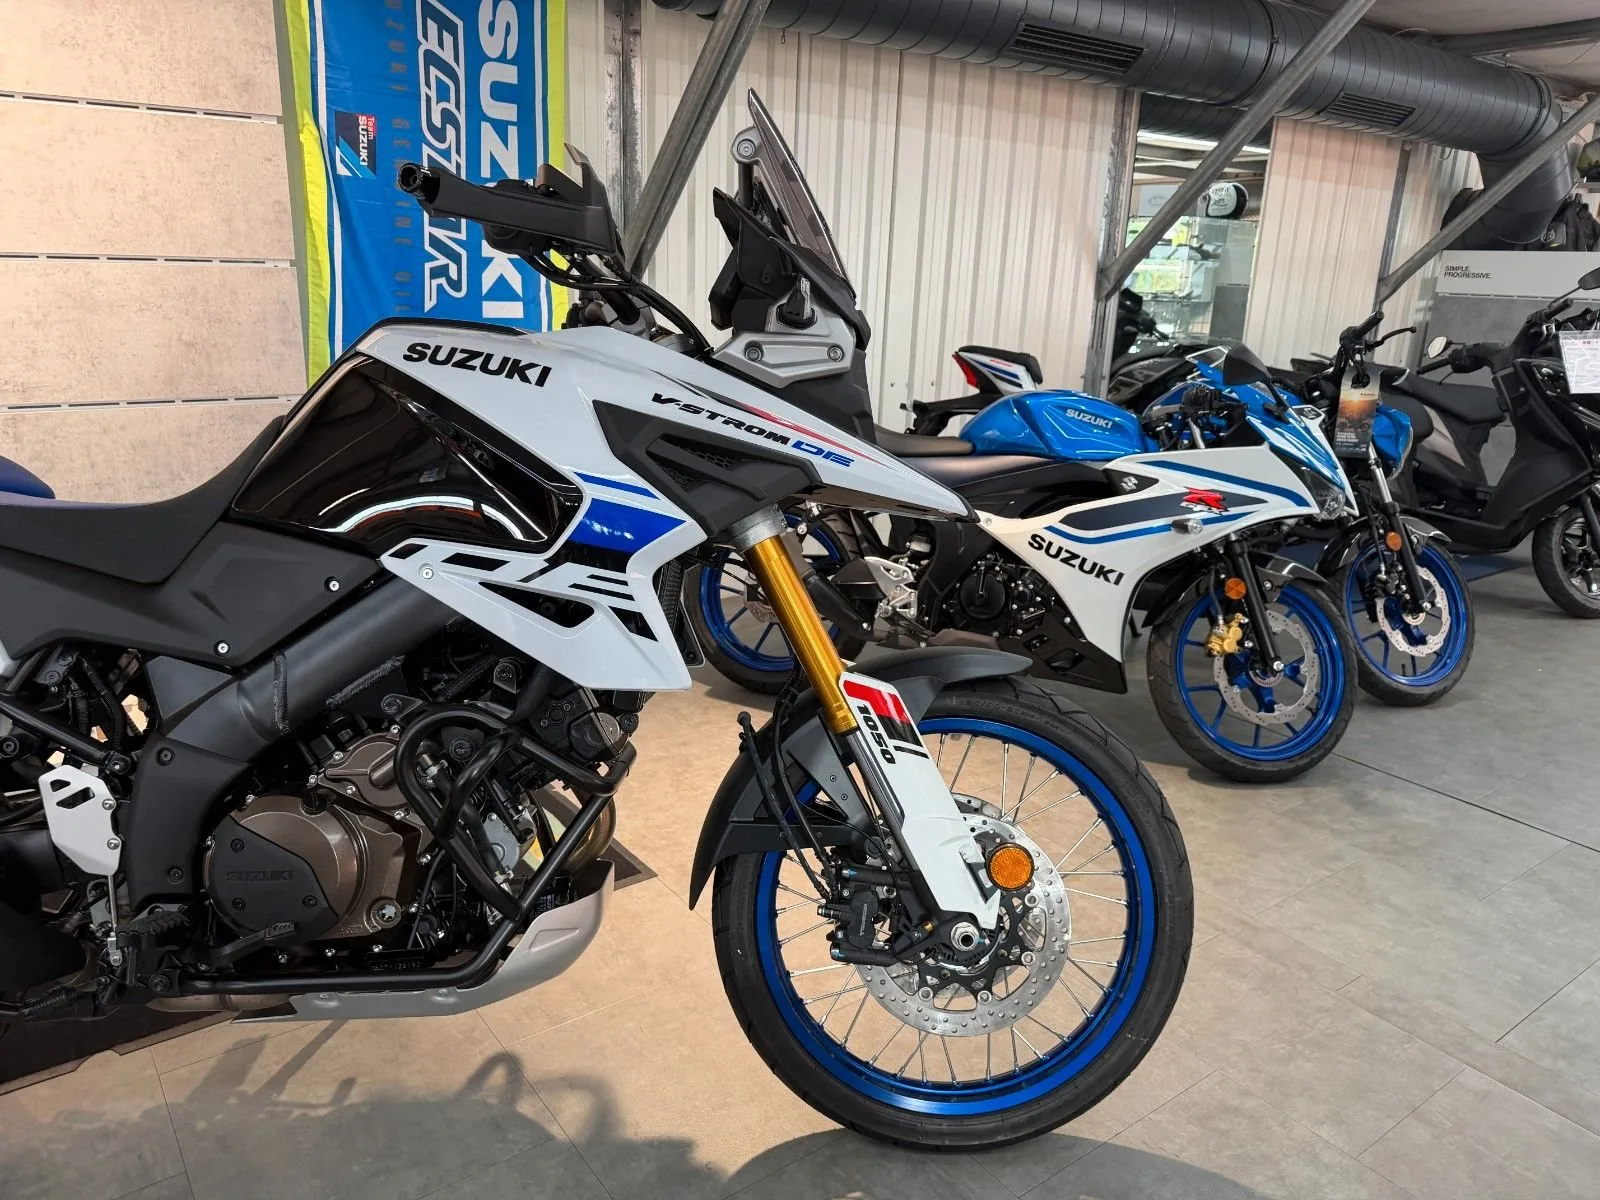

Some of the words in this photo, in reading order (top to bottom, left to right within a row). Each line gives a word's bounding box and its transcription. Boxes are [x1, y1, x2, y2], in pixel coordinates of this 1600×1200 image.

[358, 115, 368, 166] SUZUKI
[367, 117, 375, 140] Team
[392, 117, 412, 245] GEINE
[478, 0, 524, 318] SUZKI
[394, 271, 412, 312] OIL
[402, 342, 553, 388] SUZUKI
[651, 392, 791, 446] V-STROM
[791, 440, 855, 468] DE
[1065, 408, 1113, 429] SUZUKI
[1027, 533, 1125, 586] SUZUKI
[857, 704, 896, 764] 1050
[226, 868, 295, 882] SUZUKI
